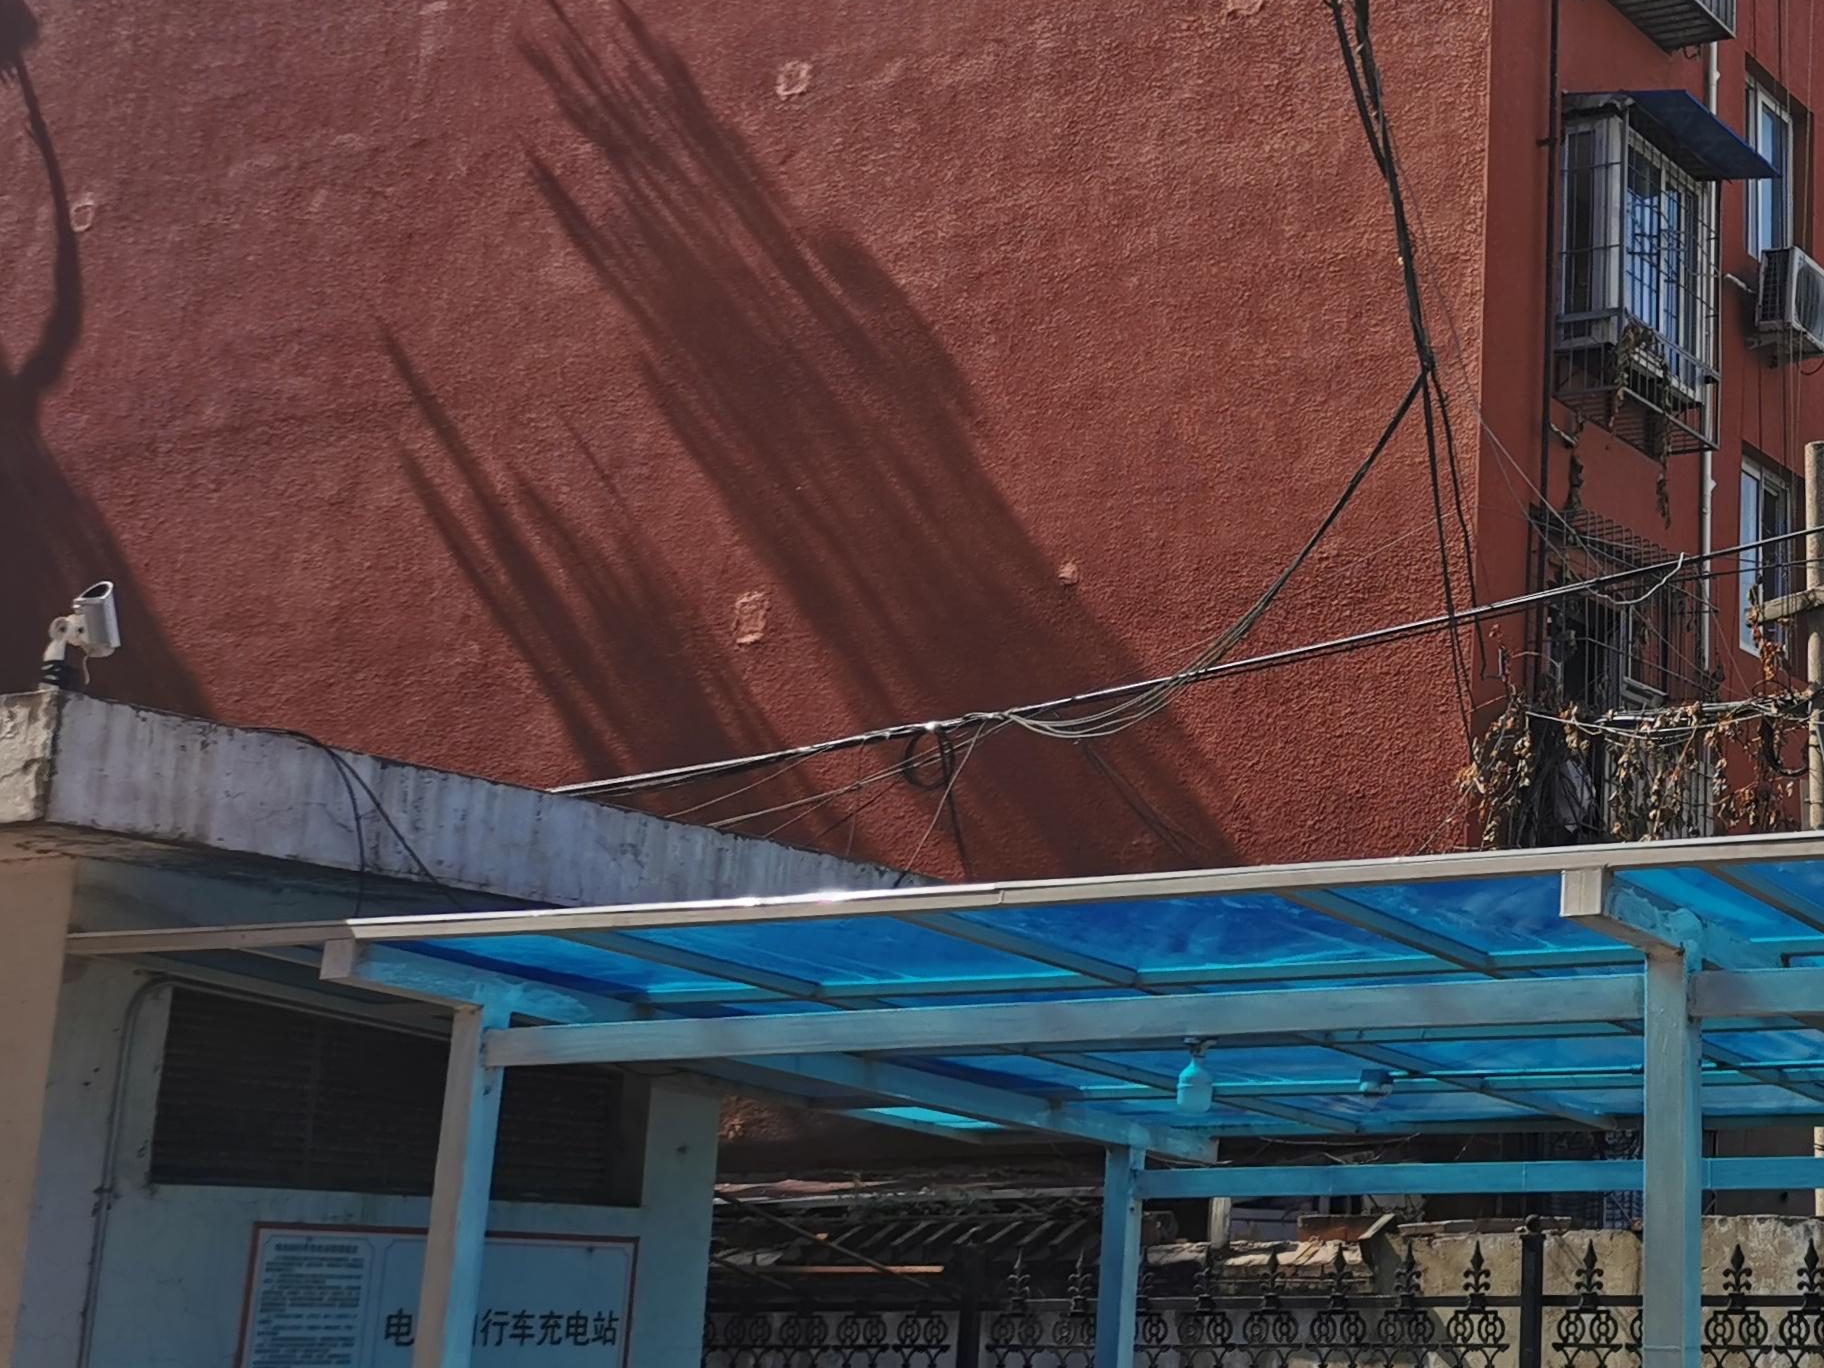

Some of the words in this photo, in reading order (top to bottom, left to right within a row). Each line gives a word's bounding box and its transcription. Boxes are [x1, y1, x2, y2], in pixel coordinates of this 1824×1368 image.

[383, 1307, 619, 1347] 电行车充电站
